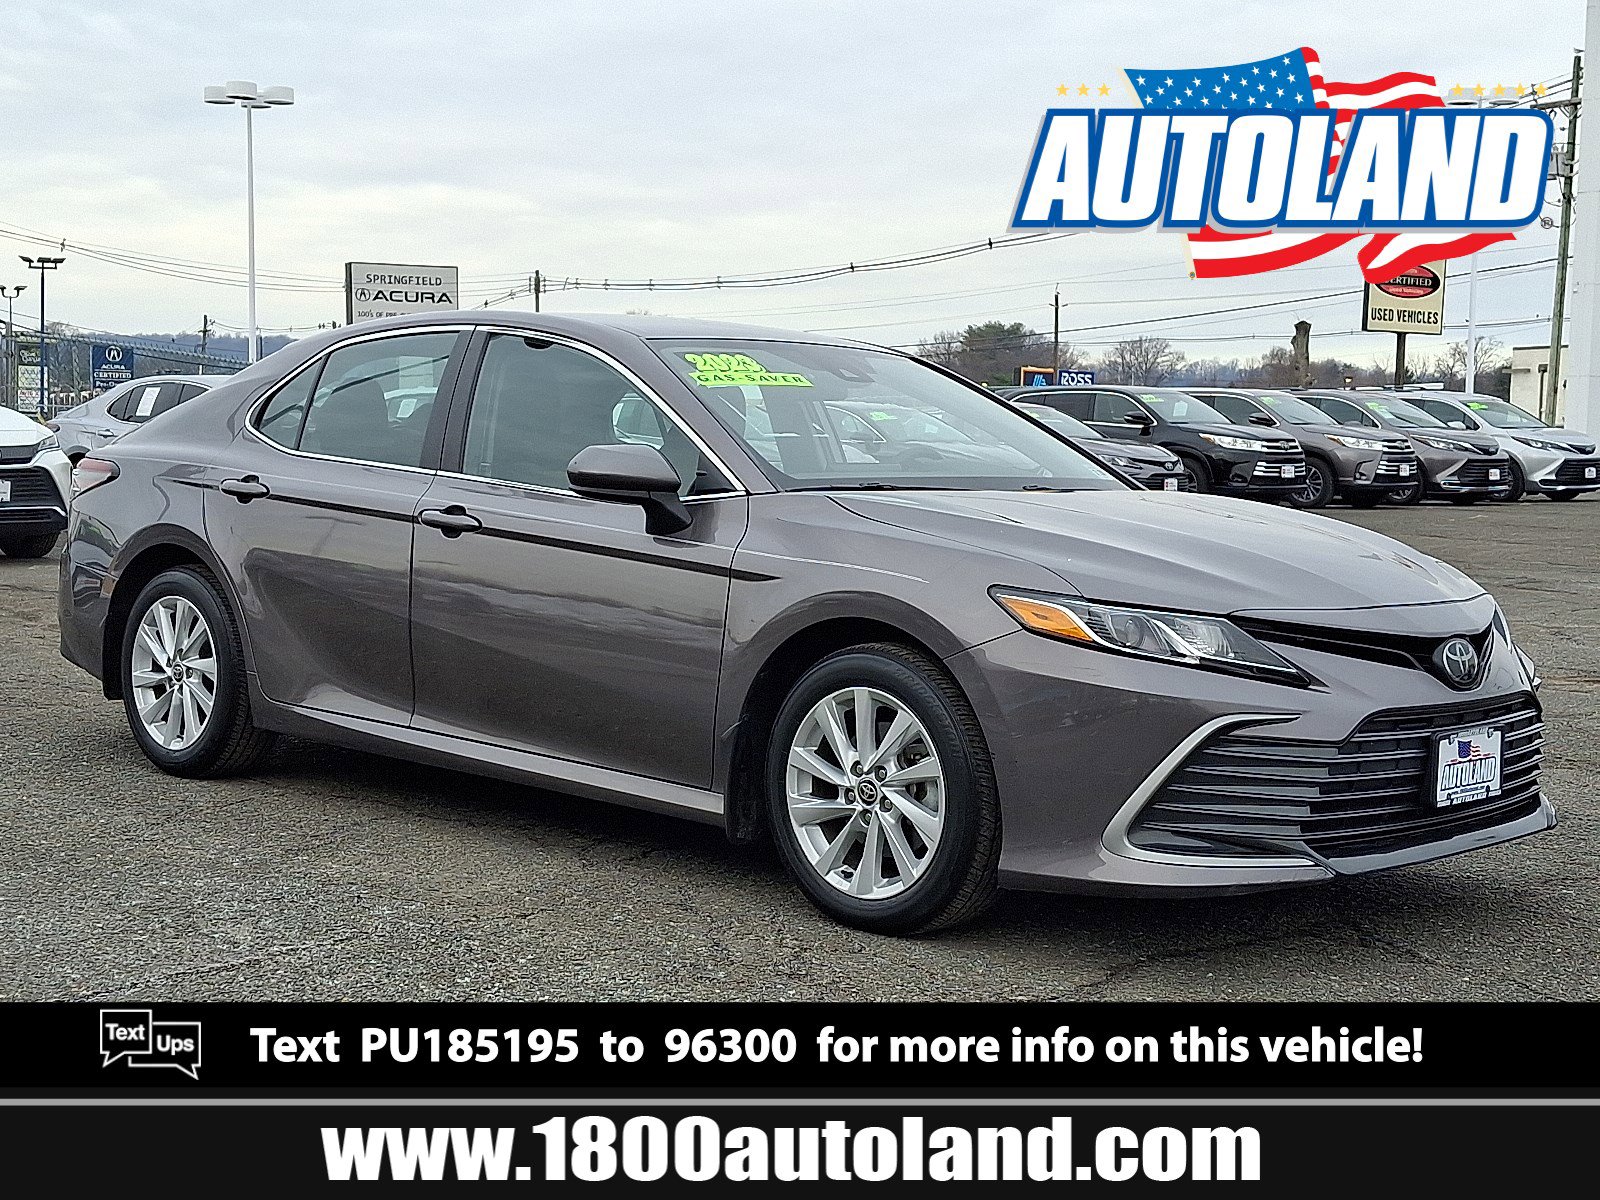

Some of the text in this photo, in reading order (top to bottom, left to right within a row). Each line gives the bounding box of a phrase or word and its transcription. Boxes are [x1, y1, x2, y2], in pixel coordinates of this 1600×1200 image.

[365, 273, 443, 287] SPRINGFIELD
[1387, 277, 1432, 286] ERTIFIED
[372, 290, 453, 305] ACURA
[1371, 307, 1439, 325] USED VEHICLES
[93, 371, 132, 379] CERTIFIED
[1060, 372, 1093, 386] ROSS
[1441, 757, 1496, 791] AUTOLAND
